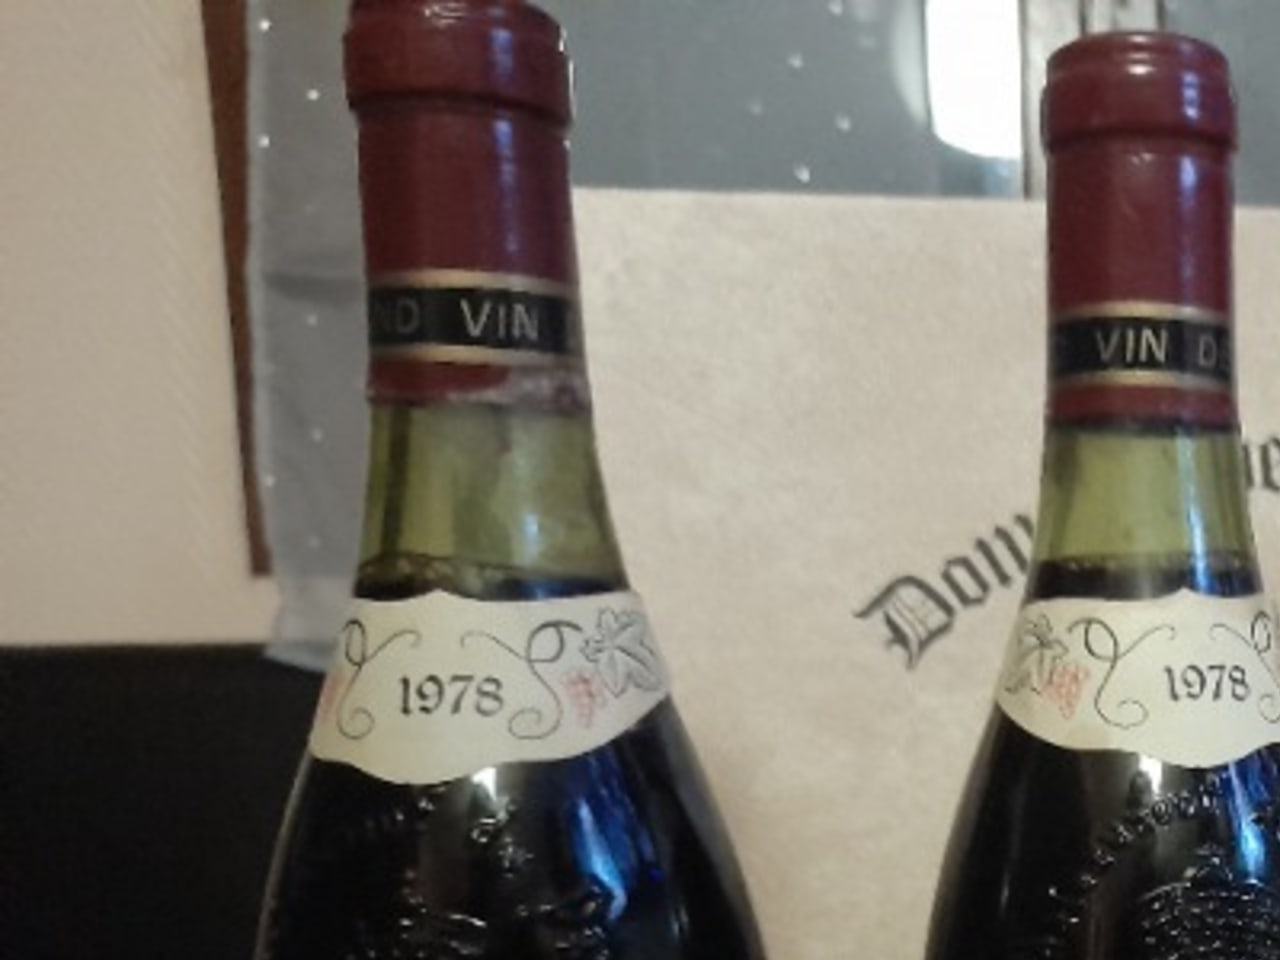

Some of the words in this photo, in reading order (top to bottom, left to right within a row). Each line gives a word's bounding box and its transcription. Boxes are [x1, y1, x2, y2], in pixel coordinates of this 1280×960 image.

[460, 298, 540, 341] VIN
[1096, 326, 1169, 364] VIN
[399, 674, 505, 716] 1978
[1165, 663, 1250, 702] 1978
